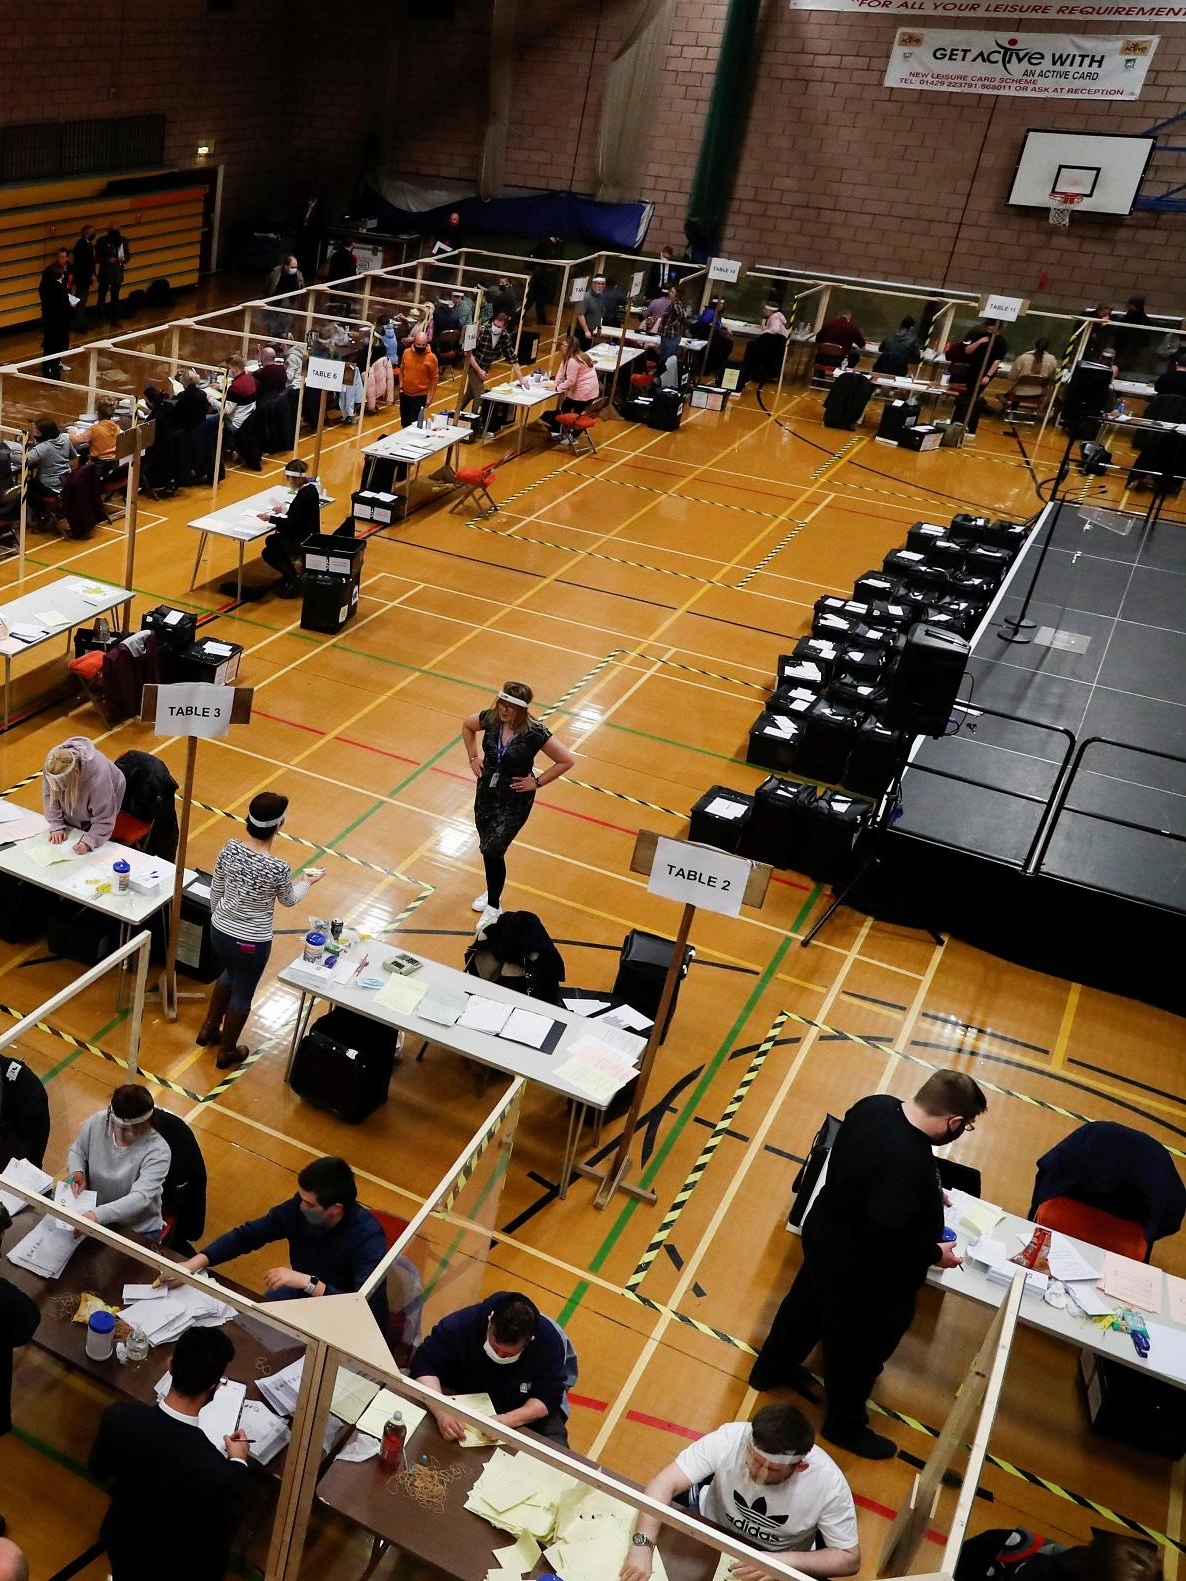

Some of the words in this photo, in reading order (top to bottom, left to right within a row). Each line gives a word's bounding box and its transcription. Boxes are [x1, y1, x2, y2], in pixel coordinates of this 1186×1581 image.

[896, 1, 925, 10] ALL
[932, 2, 981, 12] YOUR
[984, 4, 1053, 14] LEISURE
[932, 47, 972, 62] GET
[1051, 52, 1105, 68] WITH
[931, 73, 969, 81] LEISURE
[998, 78, 1039, 86] SCHEME
[1022, 69, 1037, 78] AN
[1037, 70, 1071, 80] ACTIVE
[1072, 71, 1099, 81] CARD
[919, 79, 946, 87] 01429
[1067, 88, 1124, 96] RECEPTION
[312, 369, 332, 379] TABLE
[332, 372, 338, 380] 6
[168, 706, 210, 718] TABLE
[214, 707, 221, 718] 3
[666, 864, 718, 888] TABLE
[720, 880, 731, 891] 2
[725, 1512, 780, 1543] adidas
